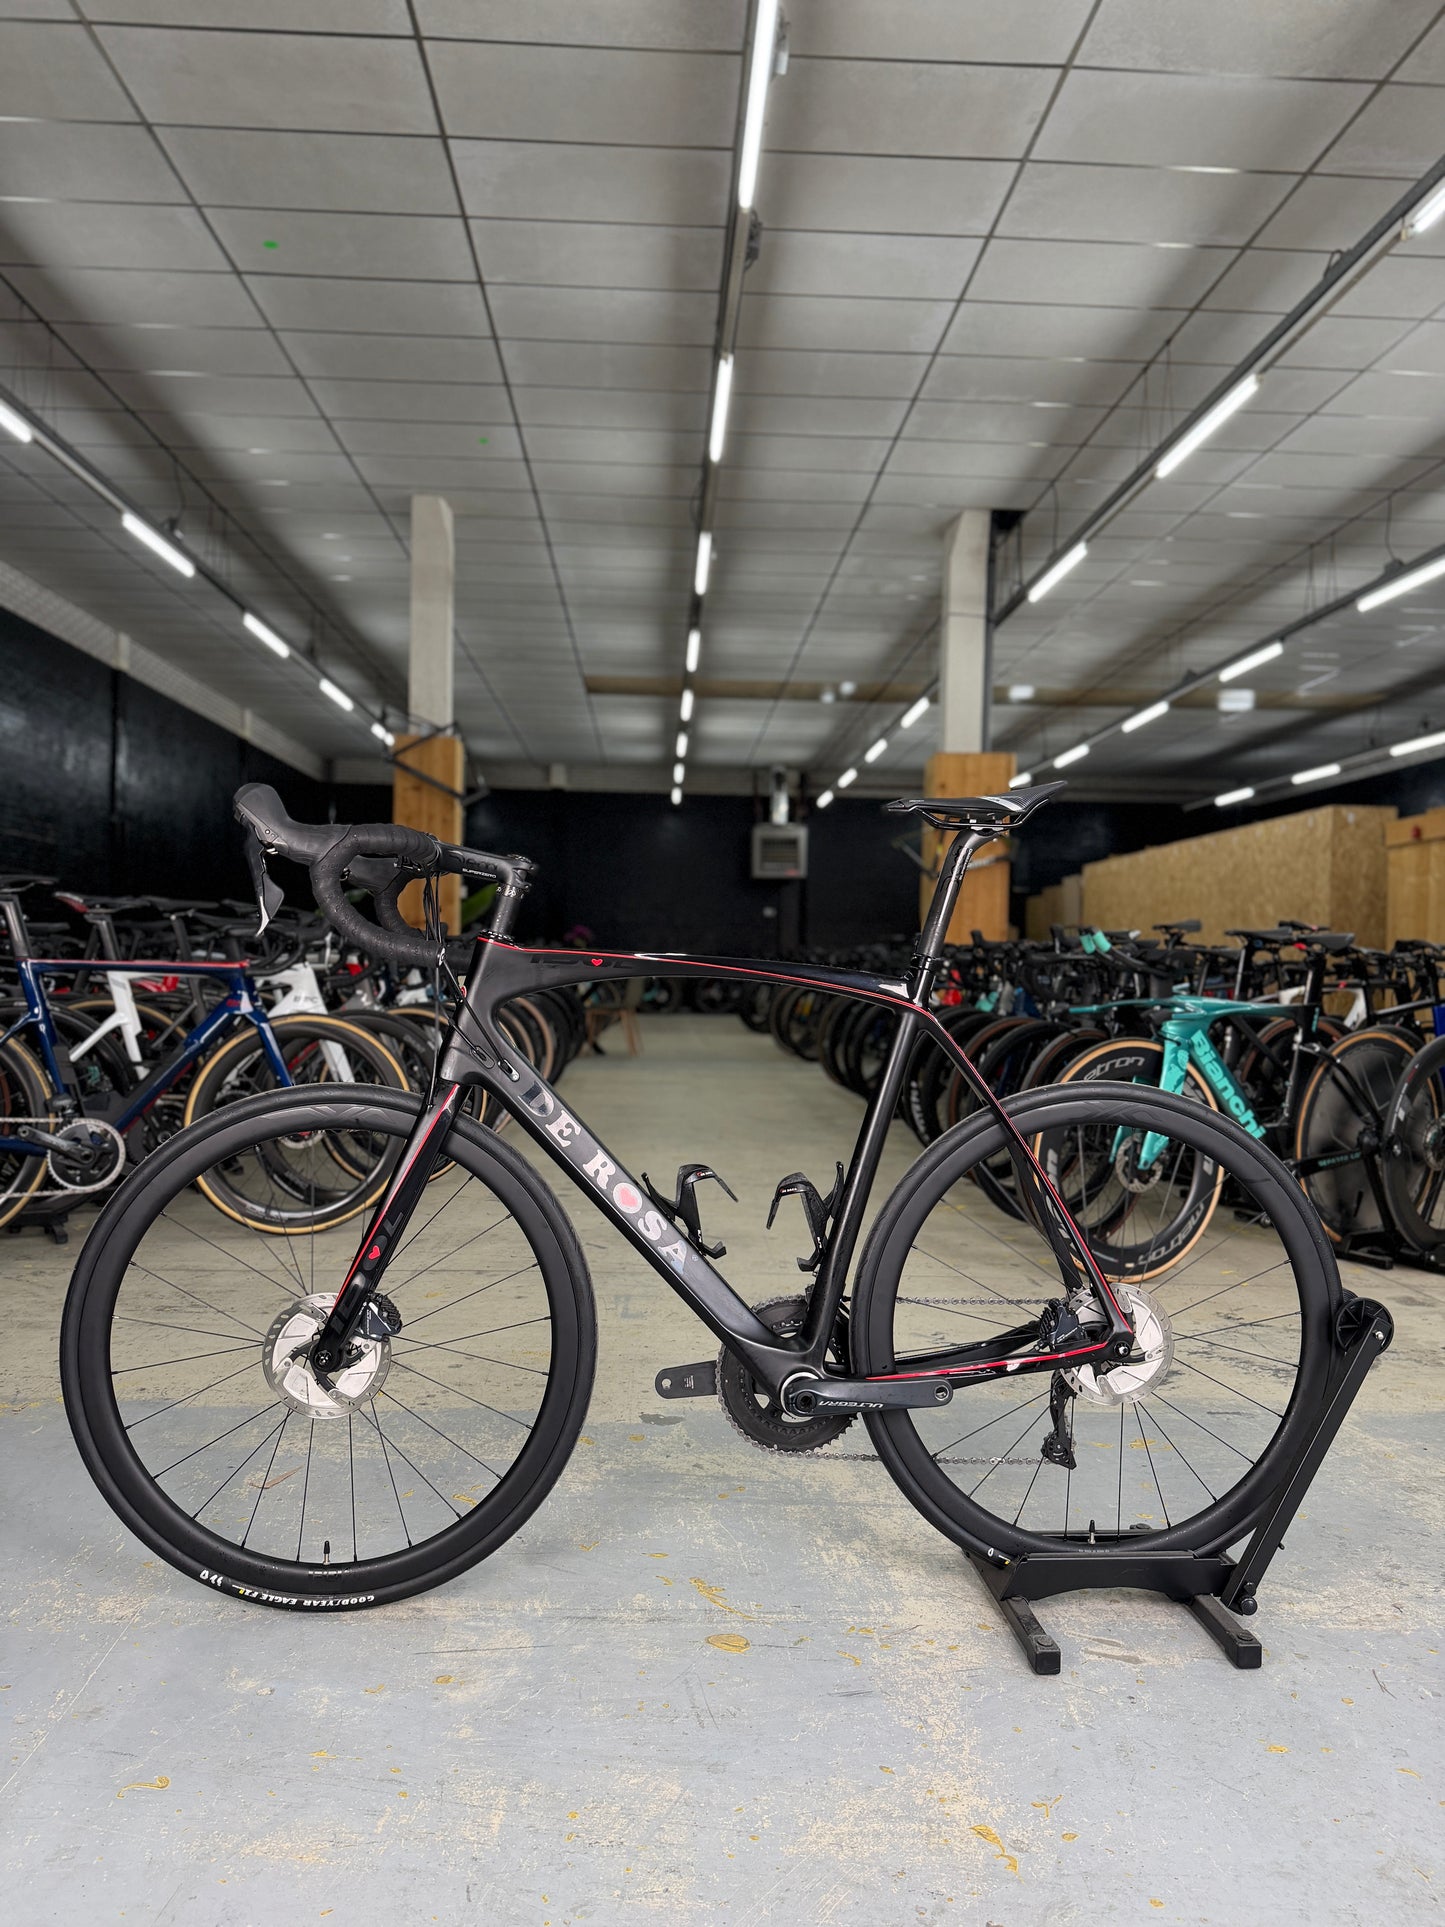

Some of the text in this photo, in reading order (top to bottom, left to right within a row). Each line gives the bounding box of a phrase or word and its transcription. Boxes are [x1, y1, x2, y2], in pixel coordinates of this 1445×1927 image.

[1083, 1056, 1145, 1081] etron
[1190, 1029, 1268, 1139] Bianchi
[517, 1080, 688, 1275] DE ROSA
[818, 1400, 884, 1409] ULTEGRA
[259, 1592, 298, 1606] EAGLE
